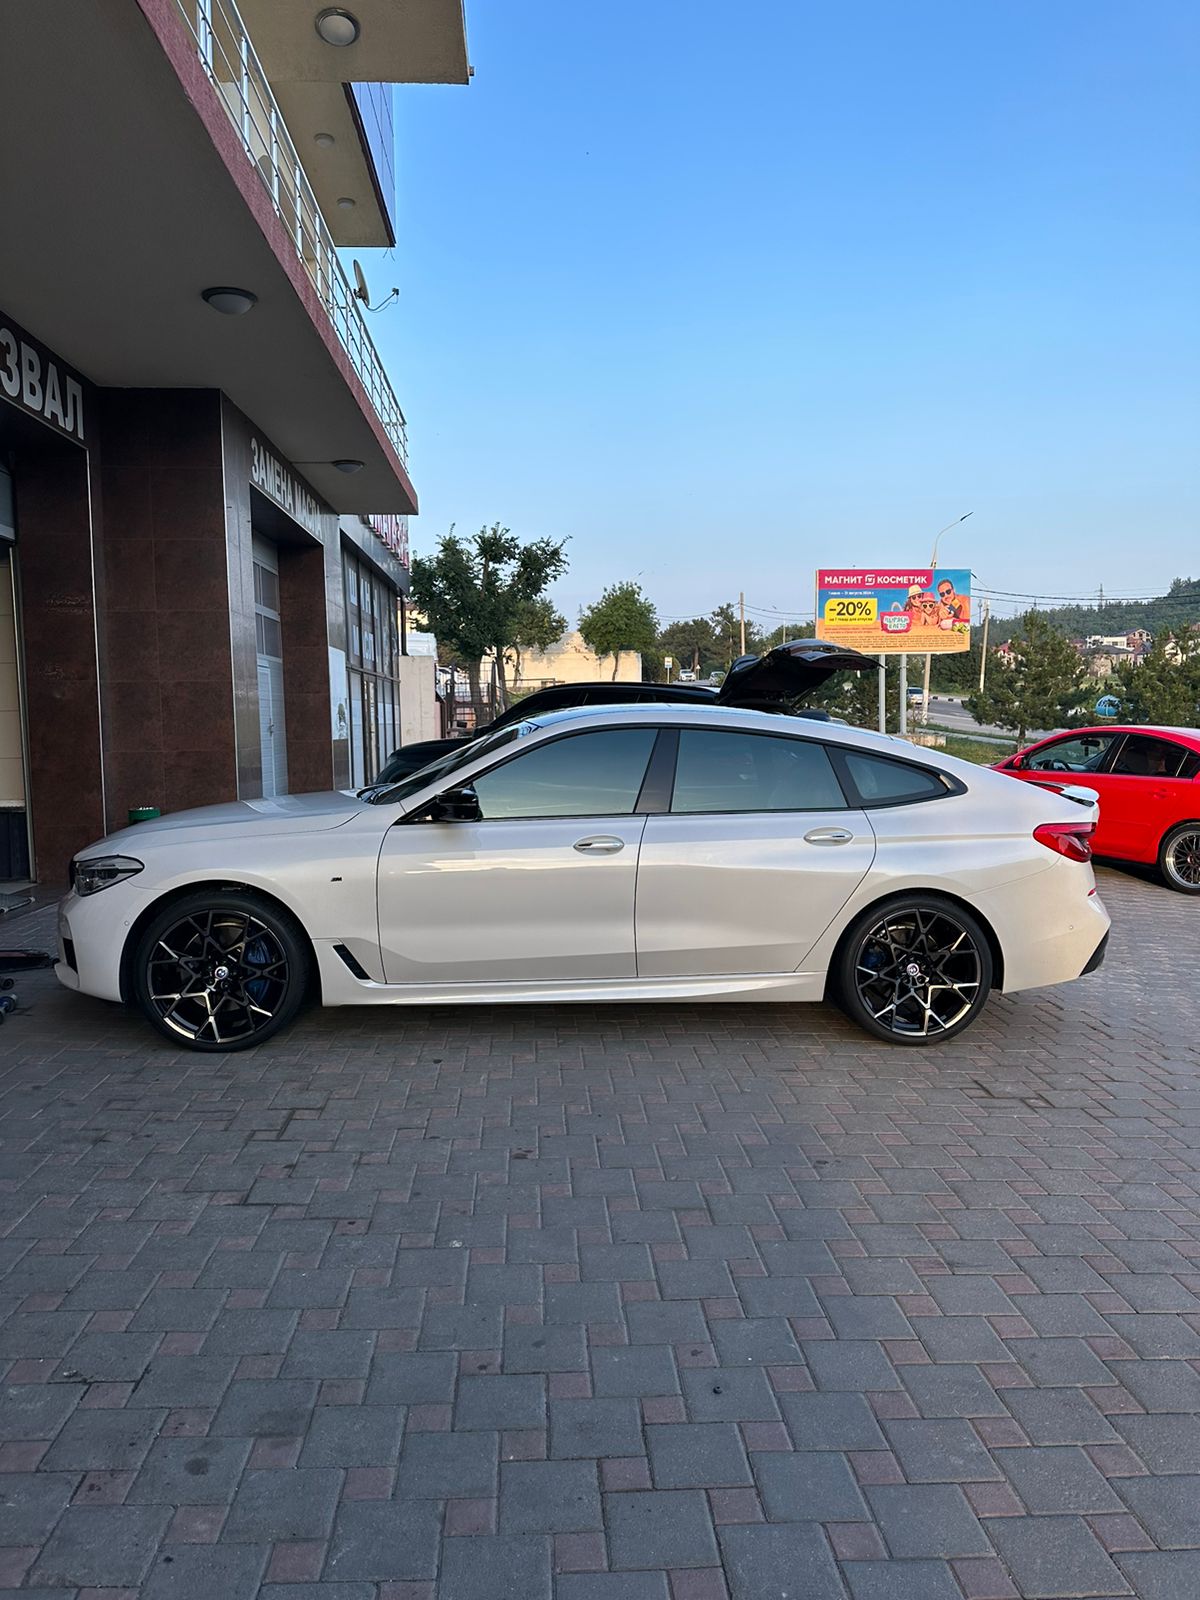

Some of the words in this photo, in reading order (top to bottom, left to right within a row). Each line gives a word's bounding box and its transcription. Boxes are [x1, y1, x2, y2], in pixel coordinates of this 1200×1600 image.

[0, 327, 84, 440] ЗВАЛ
[251, 437, 294, 513] ЗАМЕНА
[824, 575, 862, 585] МАГНИТ
[877, 575, 928, 585] КОСМЕТИК
[829, 601, 871, 616] -20%
